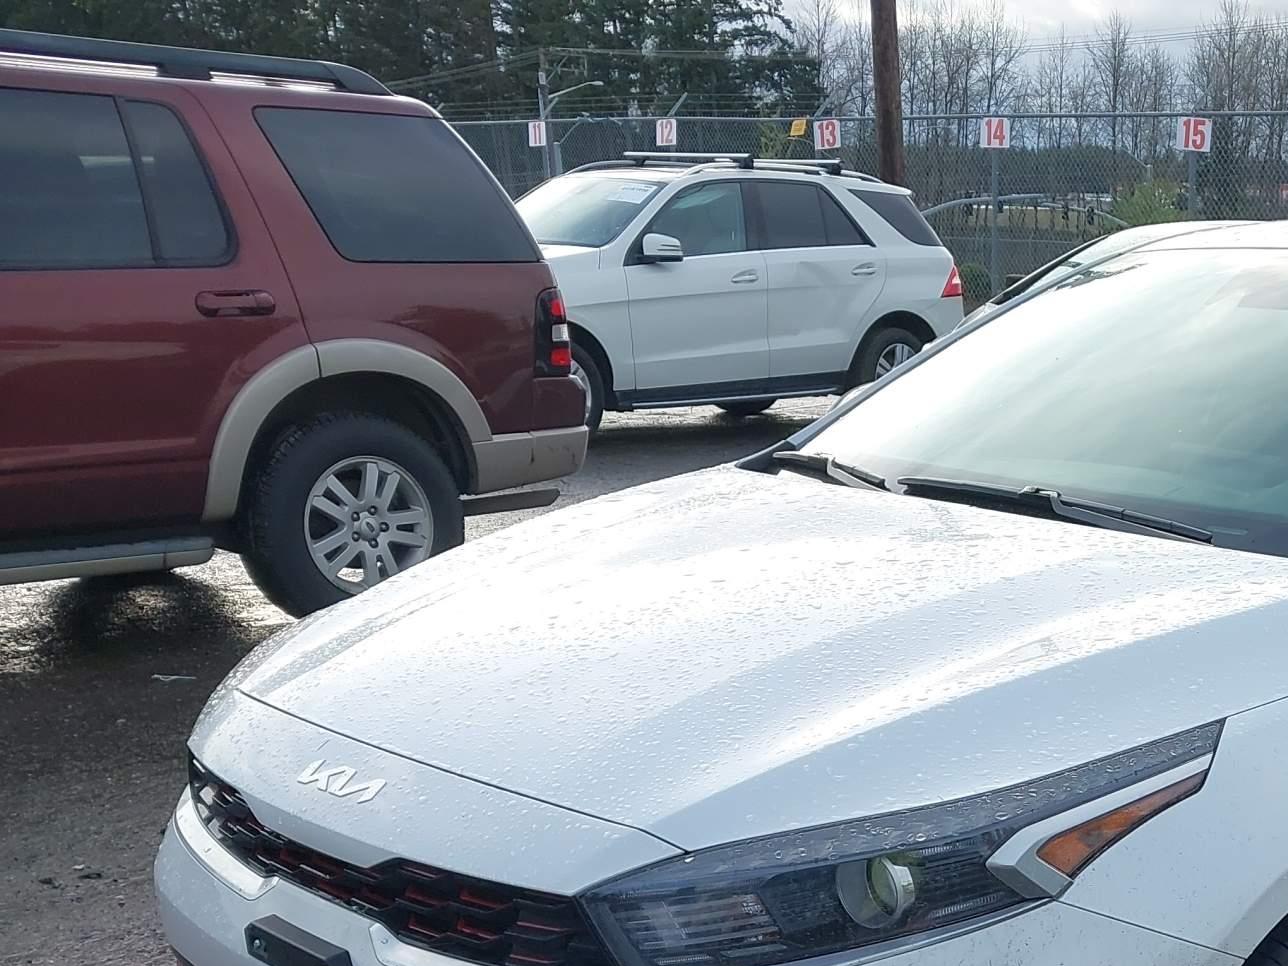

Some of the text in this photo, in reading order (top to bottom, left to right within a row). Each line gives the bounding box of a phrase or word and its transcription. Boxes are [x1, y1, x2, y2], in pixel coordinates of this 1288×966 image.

[532, 123, 542, 145] 11
[659, 121, 674, 144] 12
[817, 121, 837, 148] 13
[984, 119, 1006, 146] 14
[1182, 118, 1206, 150] 15
[296, 760, 388, 804] KIA
